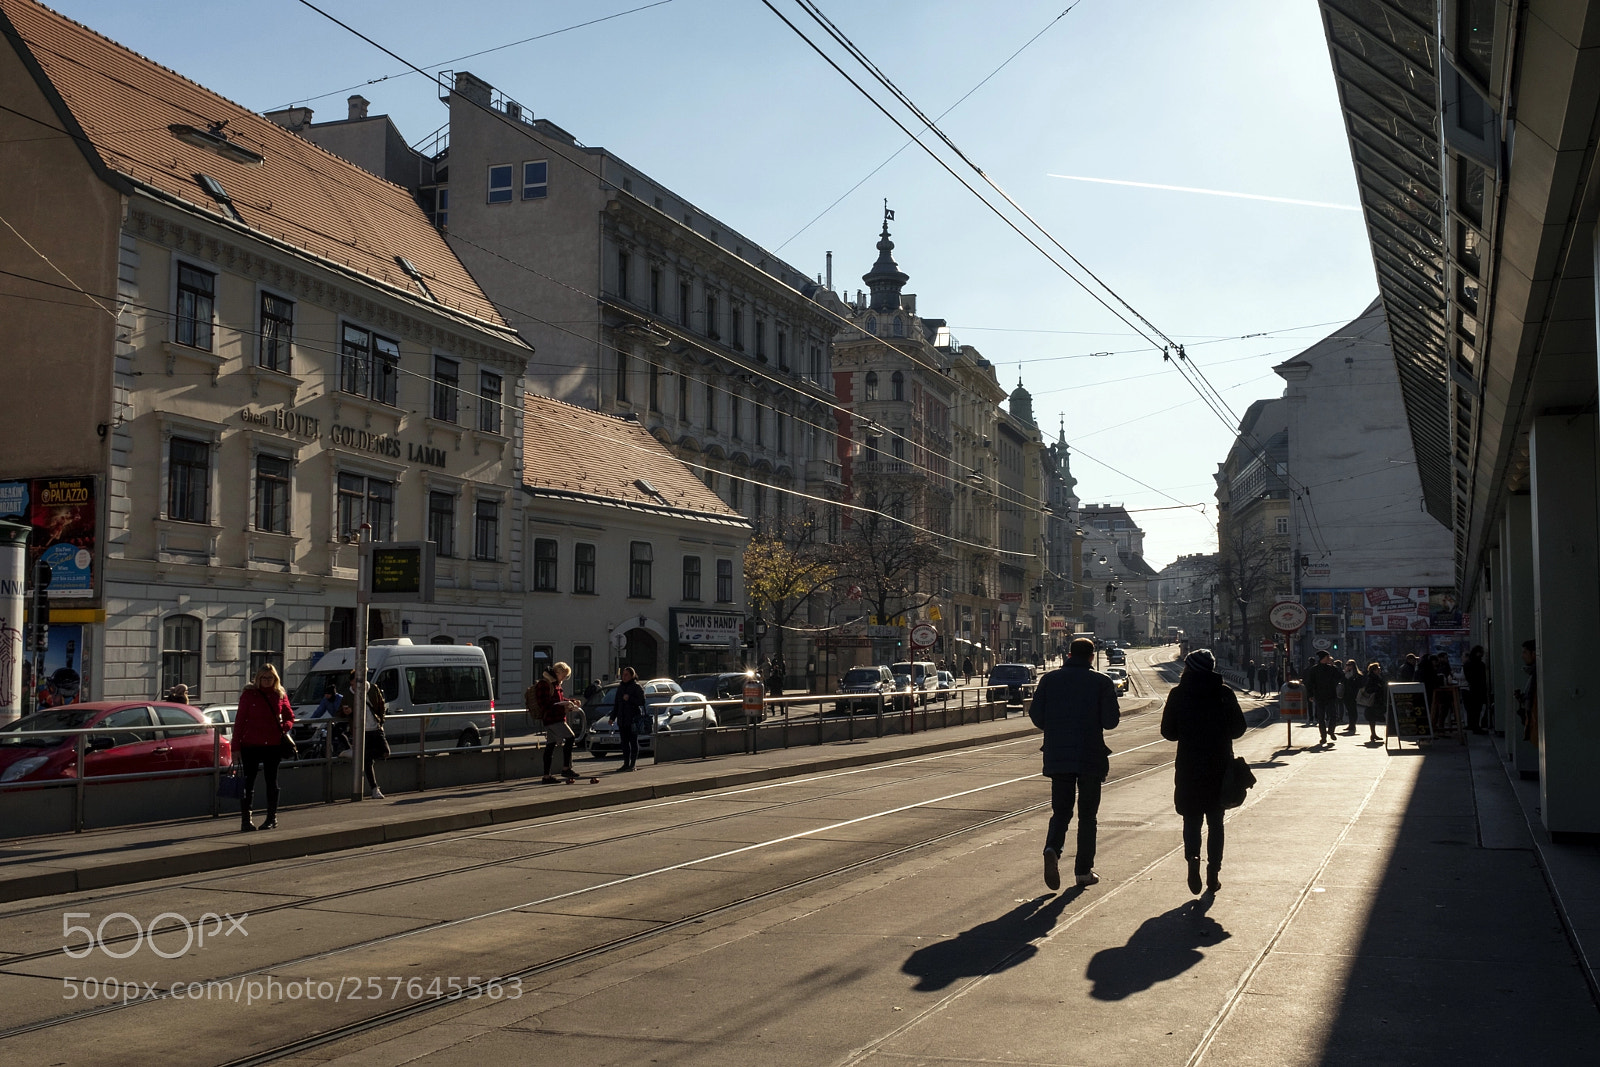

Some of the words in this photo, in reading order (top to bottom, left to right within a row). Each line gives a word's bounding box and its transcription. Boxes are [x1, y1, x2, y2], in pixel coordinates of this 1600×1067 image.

[274, 407, 322, 438] HOTEL
[331, 424, 401, 458] GOLDENES
[408, 442, 447, 468] LAMM
[51, 488, 88, 502] PALAZZO
[685, 615, 712, 628] JOHN'S
[713, 616, 738, 629] HANDY
